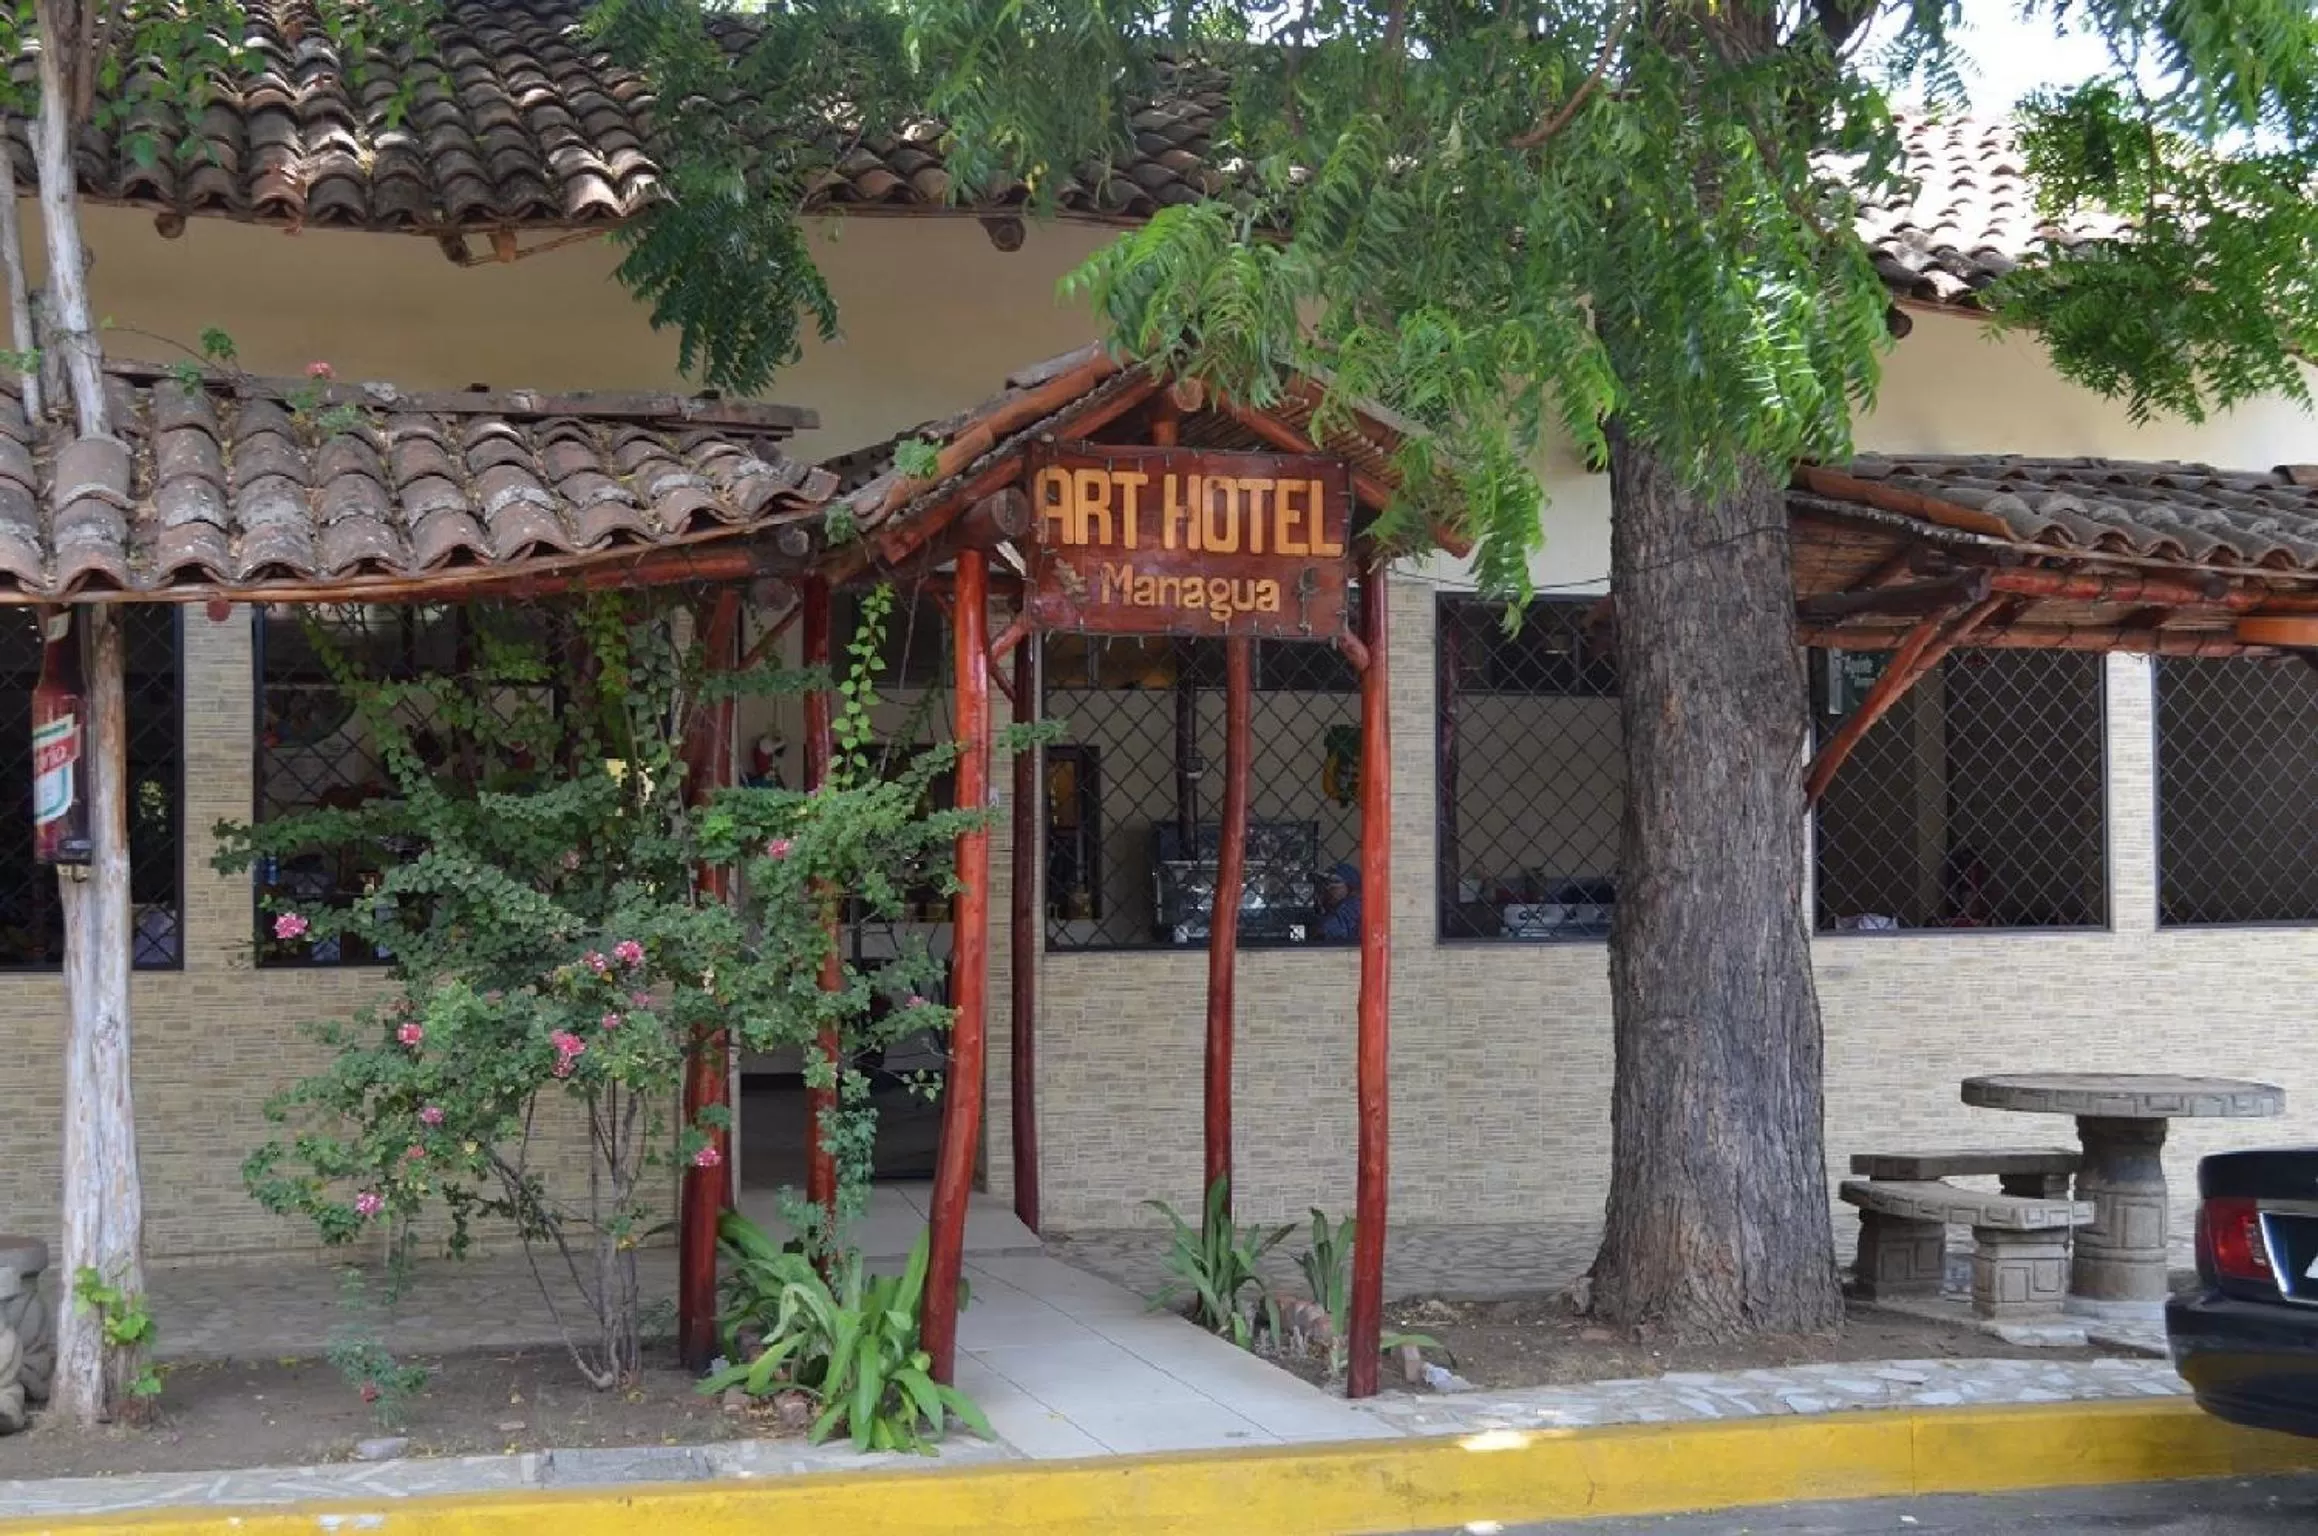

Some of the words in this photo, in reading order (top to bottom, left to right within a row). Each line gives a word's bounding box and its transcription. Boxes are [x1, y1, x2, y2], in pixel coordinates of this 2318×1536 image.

[1034, 466, 1149, 550] ART
[1163, 473, 1344, 557] HOTEL
[1101, 562, 1281, 622] Managua
